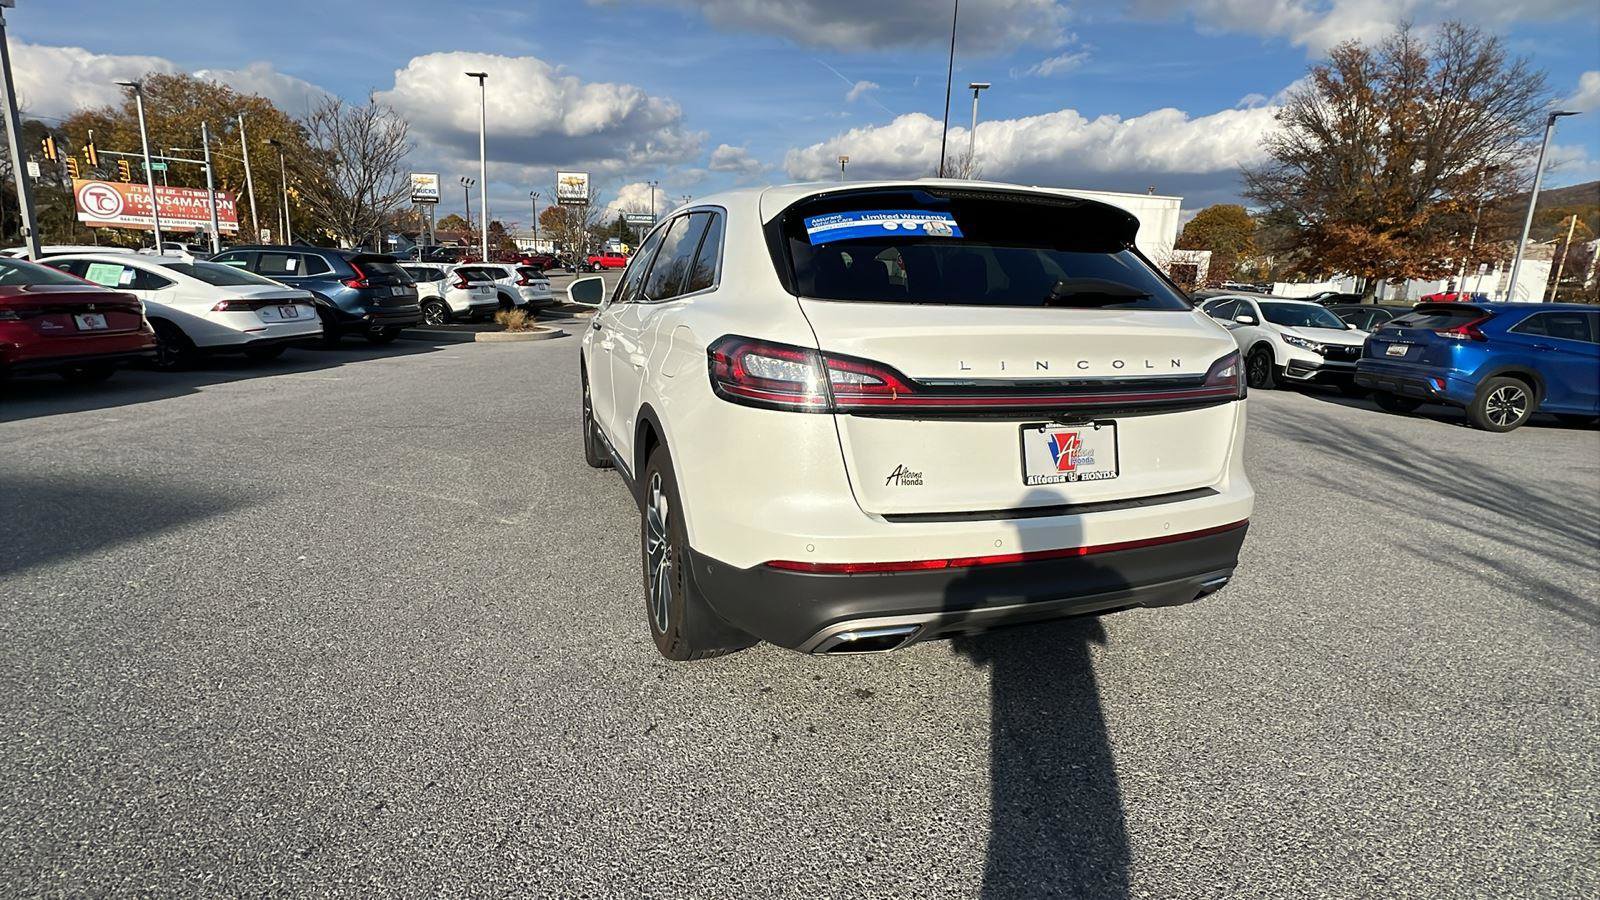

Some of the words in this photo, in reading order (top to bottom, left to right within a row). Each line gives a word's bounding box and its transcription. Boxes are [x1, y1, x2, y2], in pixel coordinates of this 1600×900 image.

[861, 213, 899, 221] Limited
[899, 213, 947, 221] Warranty
[959, 358, 1182, 372] LINCOLN
[901, 478, 924, 486] Honda
[1027, 474, 1066, 485] Altoona
[1081, 471, 1118, 481] HONDA
